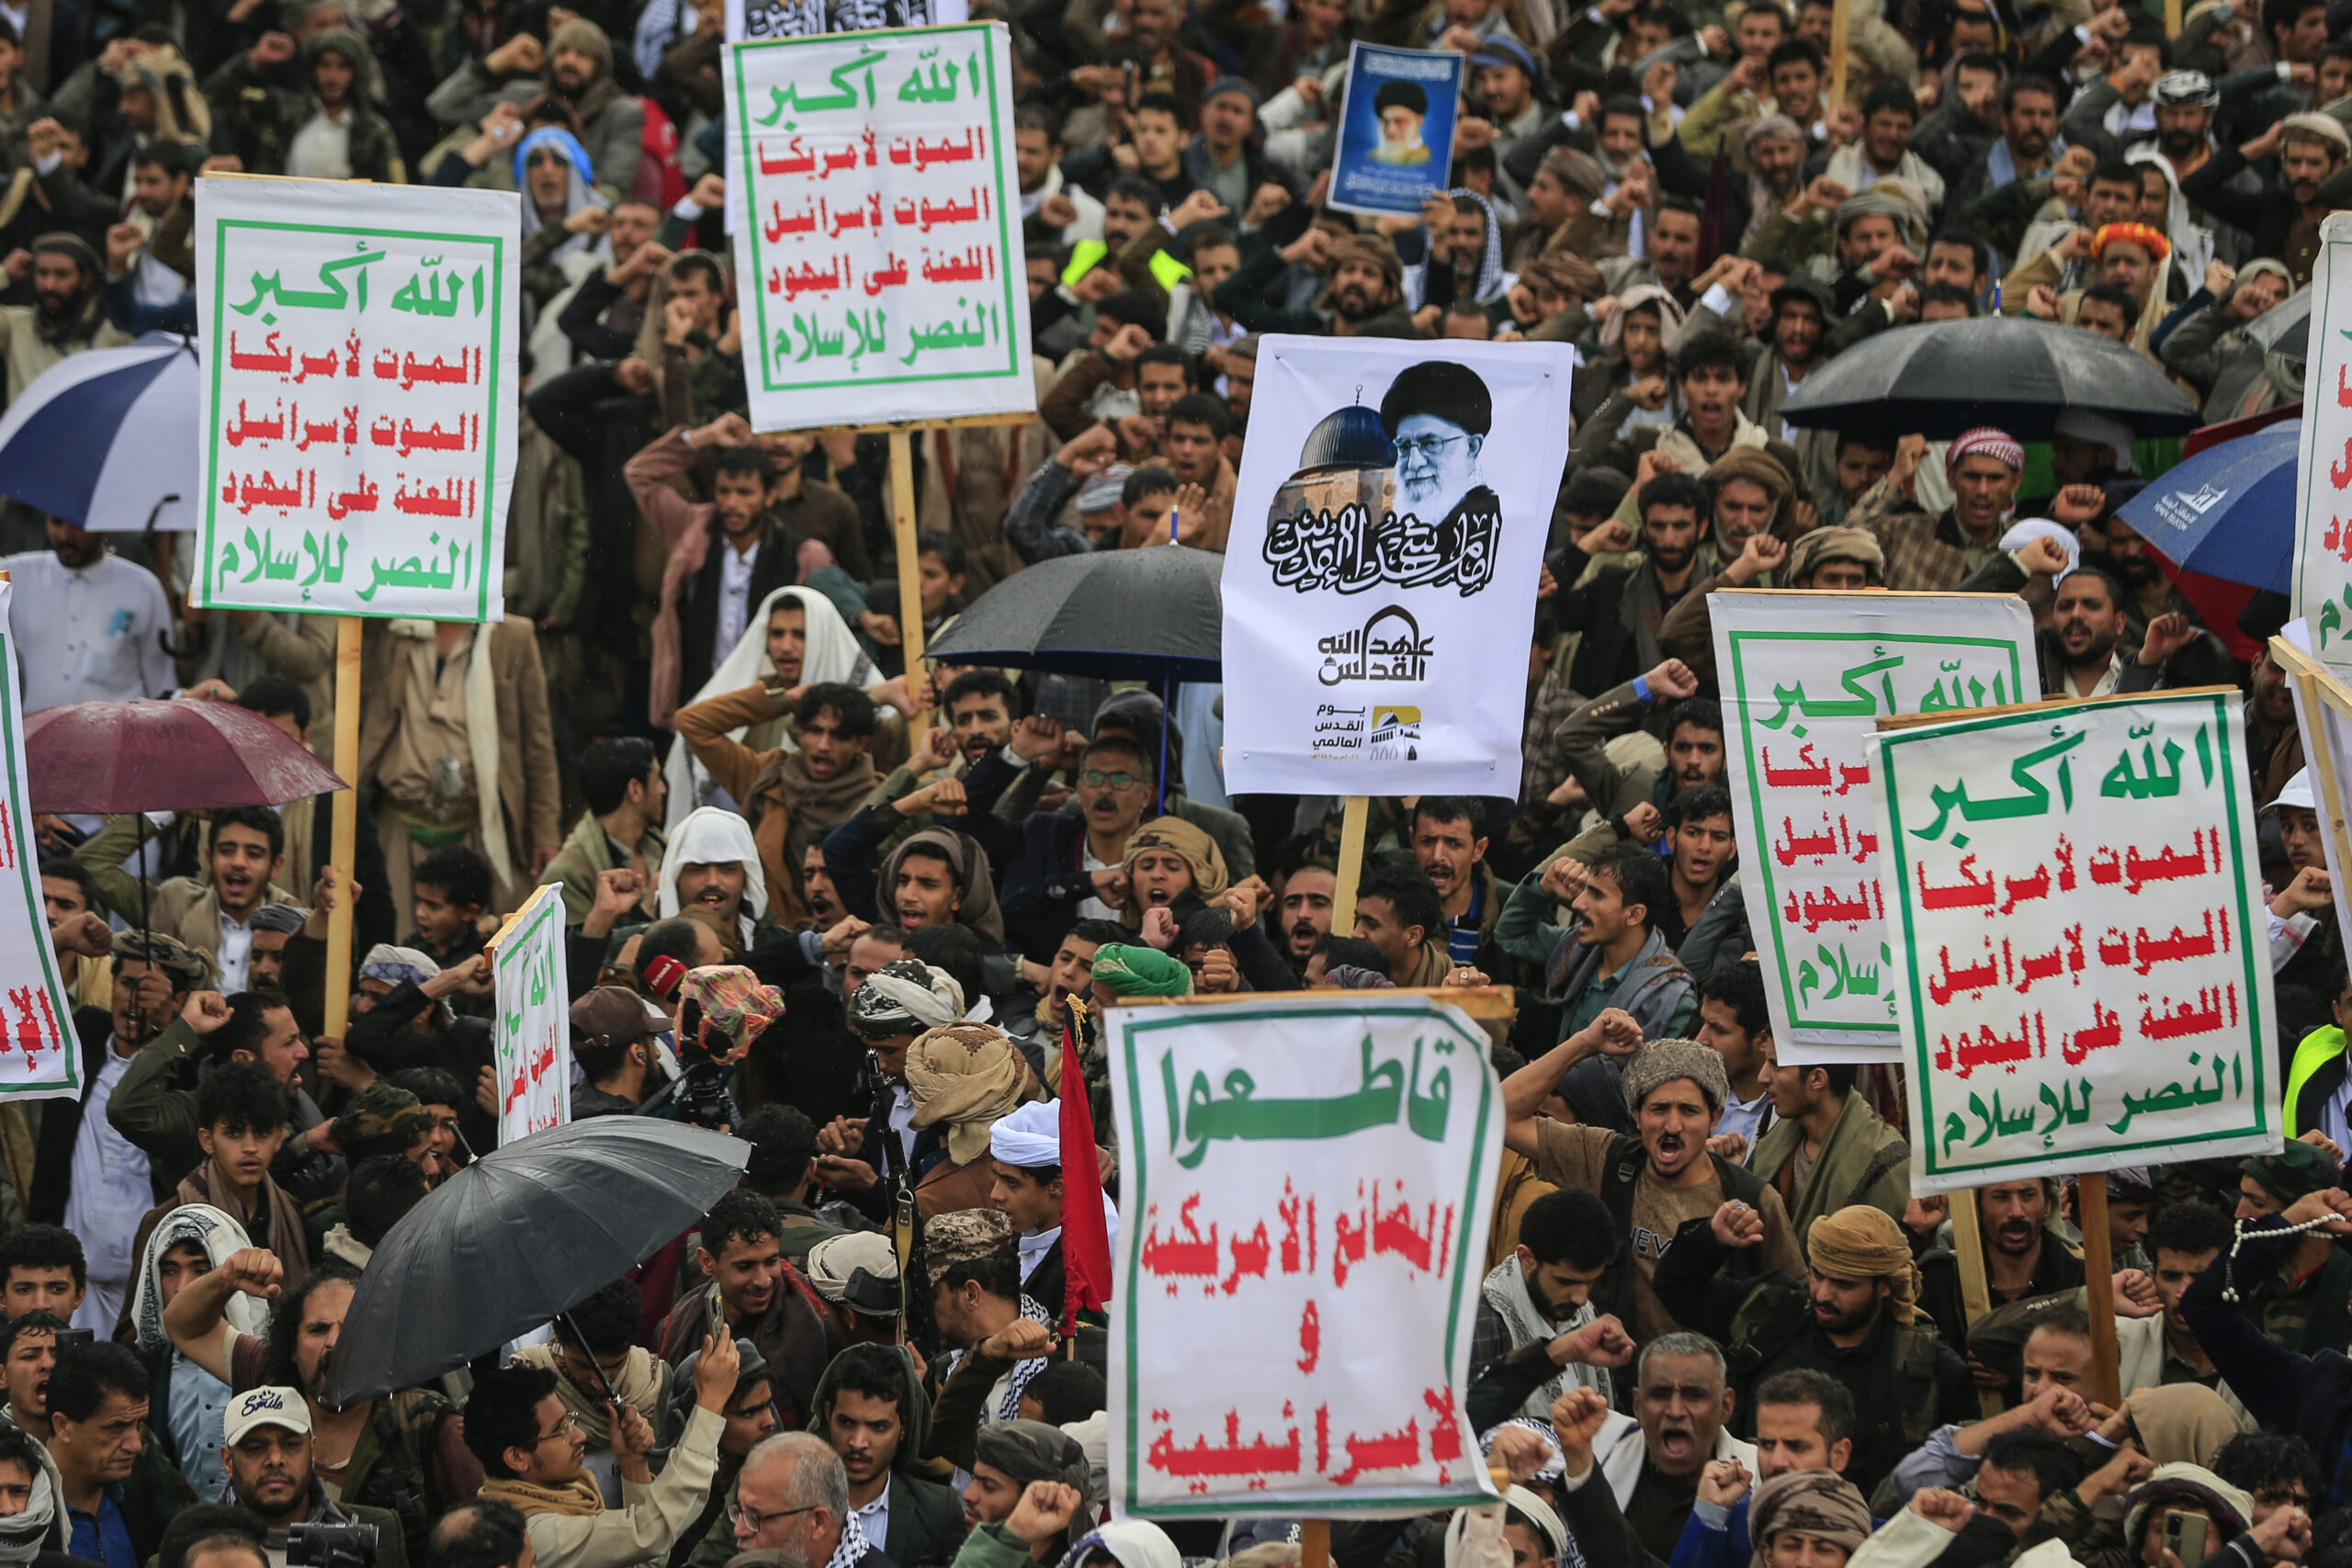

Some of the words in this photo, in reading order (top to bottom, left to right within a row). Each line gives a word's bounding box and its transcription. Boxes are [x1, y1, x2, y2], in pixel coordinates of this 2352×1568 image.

[753, 43, 888, 132] أكبر
[898, 47, 981, 103] الله
[758, 123, 877, 181] لأمريكا
[888, 126, 986, 173] الموت
[763, 190, 883, 244] لإسرائيل
[893, 186, 990, 233] الموت
[229, 240, 387, 326] أكبر
[390, 254, 484, 318] الله
[767, 254, 853, 303] اليهود
[863, 251, 910, 297] على
[922, 243, 995, 284] اللعنة
[230, 327, 362, 384] لأمريكا
[774, 306, 888, 374] للإسلام
[899, 295, 1000, 367] النصر
[372, 344, 482, 391] الموت
[225, 397, 360, 457] لإسرائيل
[369, 412, 480, 459] الموت
[221, 468, 317, 517] اليهود
[327, 471, 379, 522] على
[392, 471, 477, 519] اللعنة
[218, 525, 349, 603] للإسلام
[355, 531, 473, 603] النصر
[1317, 704, 1366, 717] يوم
[1754, 645, 1905, 739] أكبر
[1312, 736, 1363, 750] العالمي
[1314, 719, 1364, 732] القدس
[1907, 723, 2086, 851] أكبر
[2099, 721, 2215, 801] الله
[1917, 831, 2078, 918] لأمريكا
[2087, 825, 2223, 897] الموت
[1782, 876, 1884, 934] اليهود
[1927, 921, 2087, 1007] لإسرائيل
[2097, 905, 2233, 977] الموت
[2060, 999, 2123, 1067] على
[2138, 980, 2240, 1042] اللعنة
[1933, 1009, 2048, 1081] اليهود
[1160, 1033, 1454, 1169] قاطعوا
[1941, 1077, 2095, 1159] للإسلام
[2106, 1050, 2245, 1135] النصر
[1140, 1174, 1318, 1298] الأمريكية
[1296, 1299, 1321, 1375] و
[241, 1393, 284, 1417] Smile
[1146, 1383, 1464, 1495] لإسرائيلية
